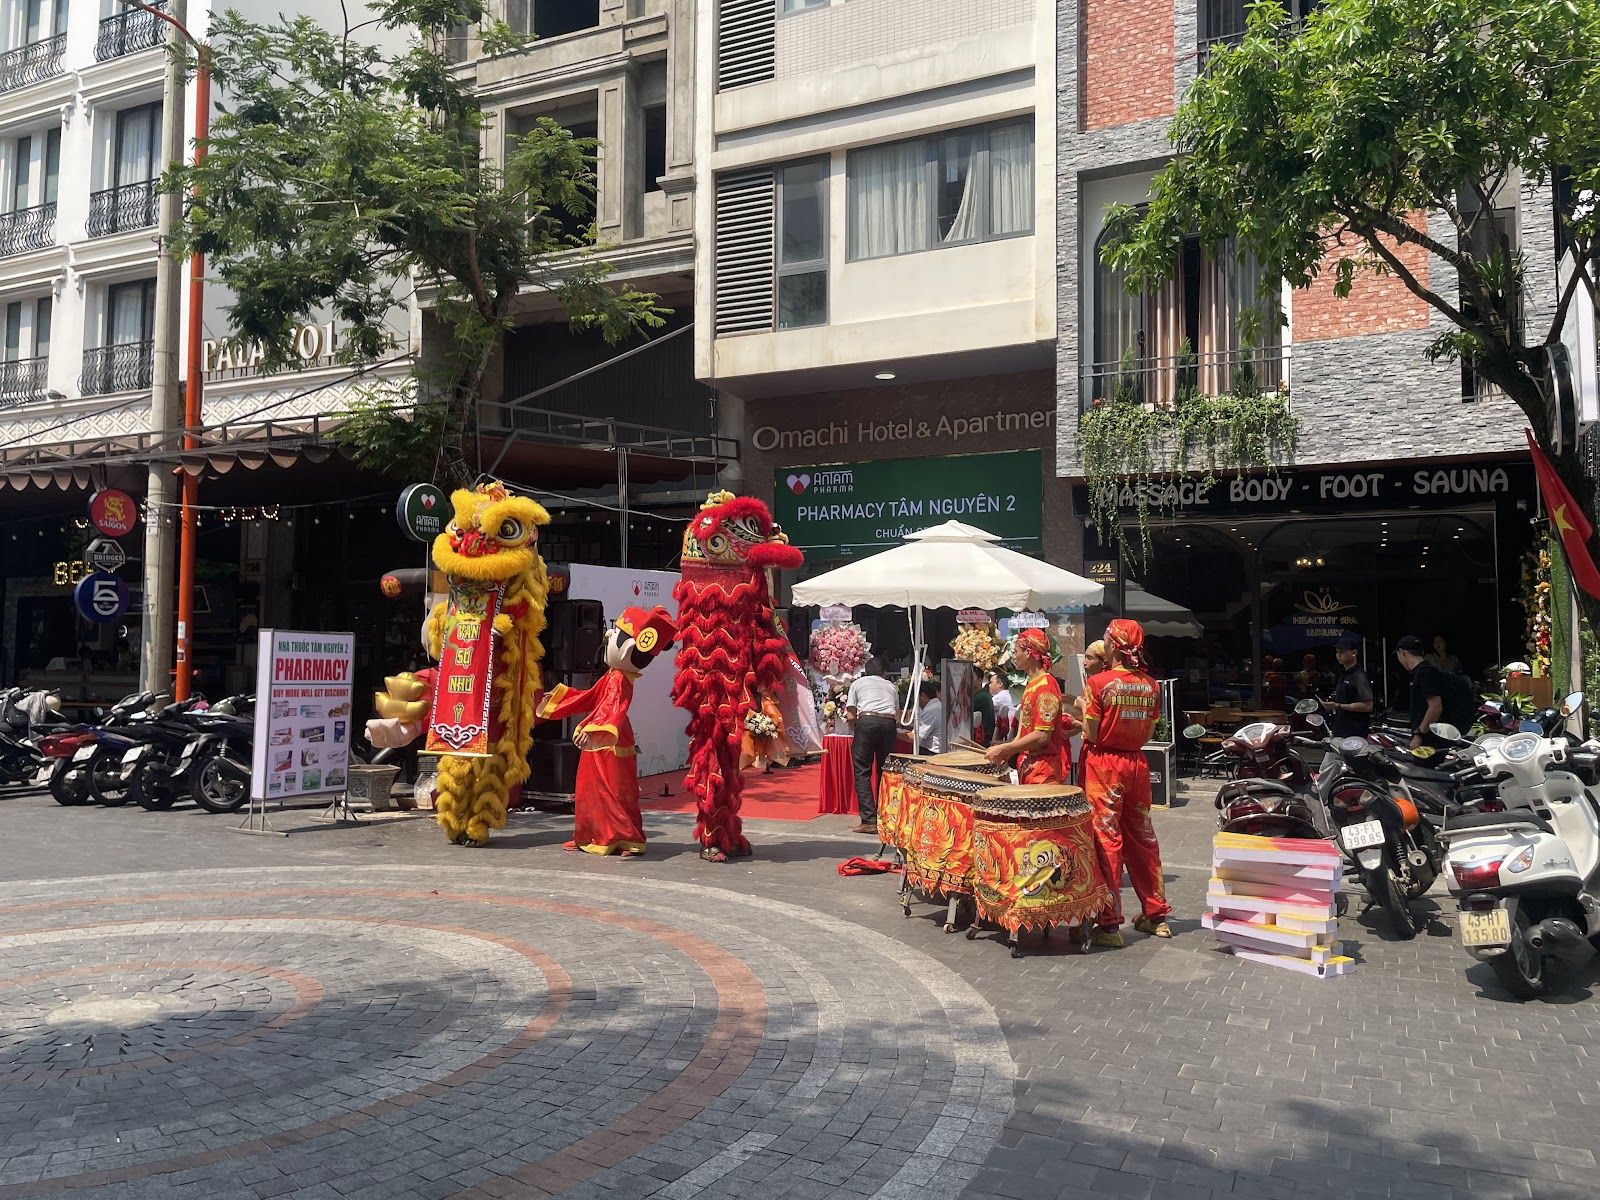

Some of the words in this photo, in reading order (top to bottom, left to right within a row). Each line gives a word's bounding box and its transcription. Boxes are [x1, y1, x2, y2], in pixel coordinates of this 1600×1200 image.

[752, 420, 848, 451] Omachi
[858, 417, 913, 443] Hotel
[916, 421, 931, 439] &
[813, 484, 854, 495] PHARMA
[1101, 482, 1210, 508] MASSAGE
[1229, 477, 1293, 502] BODY
[1320, 473, 1385, 499] FOOT
[1413, 467, 1509, 495] SAUNA
[797, 502, 885, 522] PHARMACY
[889, 497, 923, 517] TÂM
[929, 492, 1001, 516] NGUYÊN
[1006, 495, 1016, 512] 2
[98, 518, 127, 531] SAIGON
[875, 524, 914, 539] CHUẨN
[93, 553, 123, 562] BRIDGES
[1292, 616, 1338, 625] HEALTHY
[1339, 616, 1359, 625] SPA
[457, 624, 481, 643] VẠN
[1306, 628, 1345, 637] LUXURY
[278, 639, 290, 652] NHÀ
[291, 638, 310, 653] THUỐC
[311, 640, 322, 653] TÂM
[323, 641, 344, 654] NGUYÊN
[344, 643, 349, 654] 2
[455, 647, 474, 669] SỰ
[275, 657, 349, 681] PHARMACY
[448, 674, 475, 694] NHƯ
[273, 688, 284, 698] BUY
[285, 688, 300, 698] MORE
[301, 688, 313, 698] WILL
[314, 688, 323, 697] GET
[324, 688, 349, 697] DISCOUNT
[454, 702, 464, 723] Ý
[1348, 822, 1375, 837] 43-F1
[1346, 831, 1382, 848] 398.85
[1467, 911, 1500, 928] 43-H1
